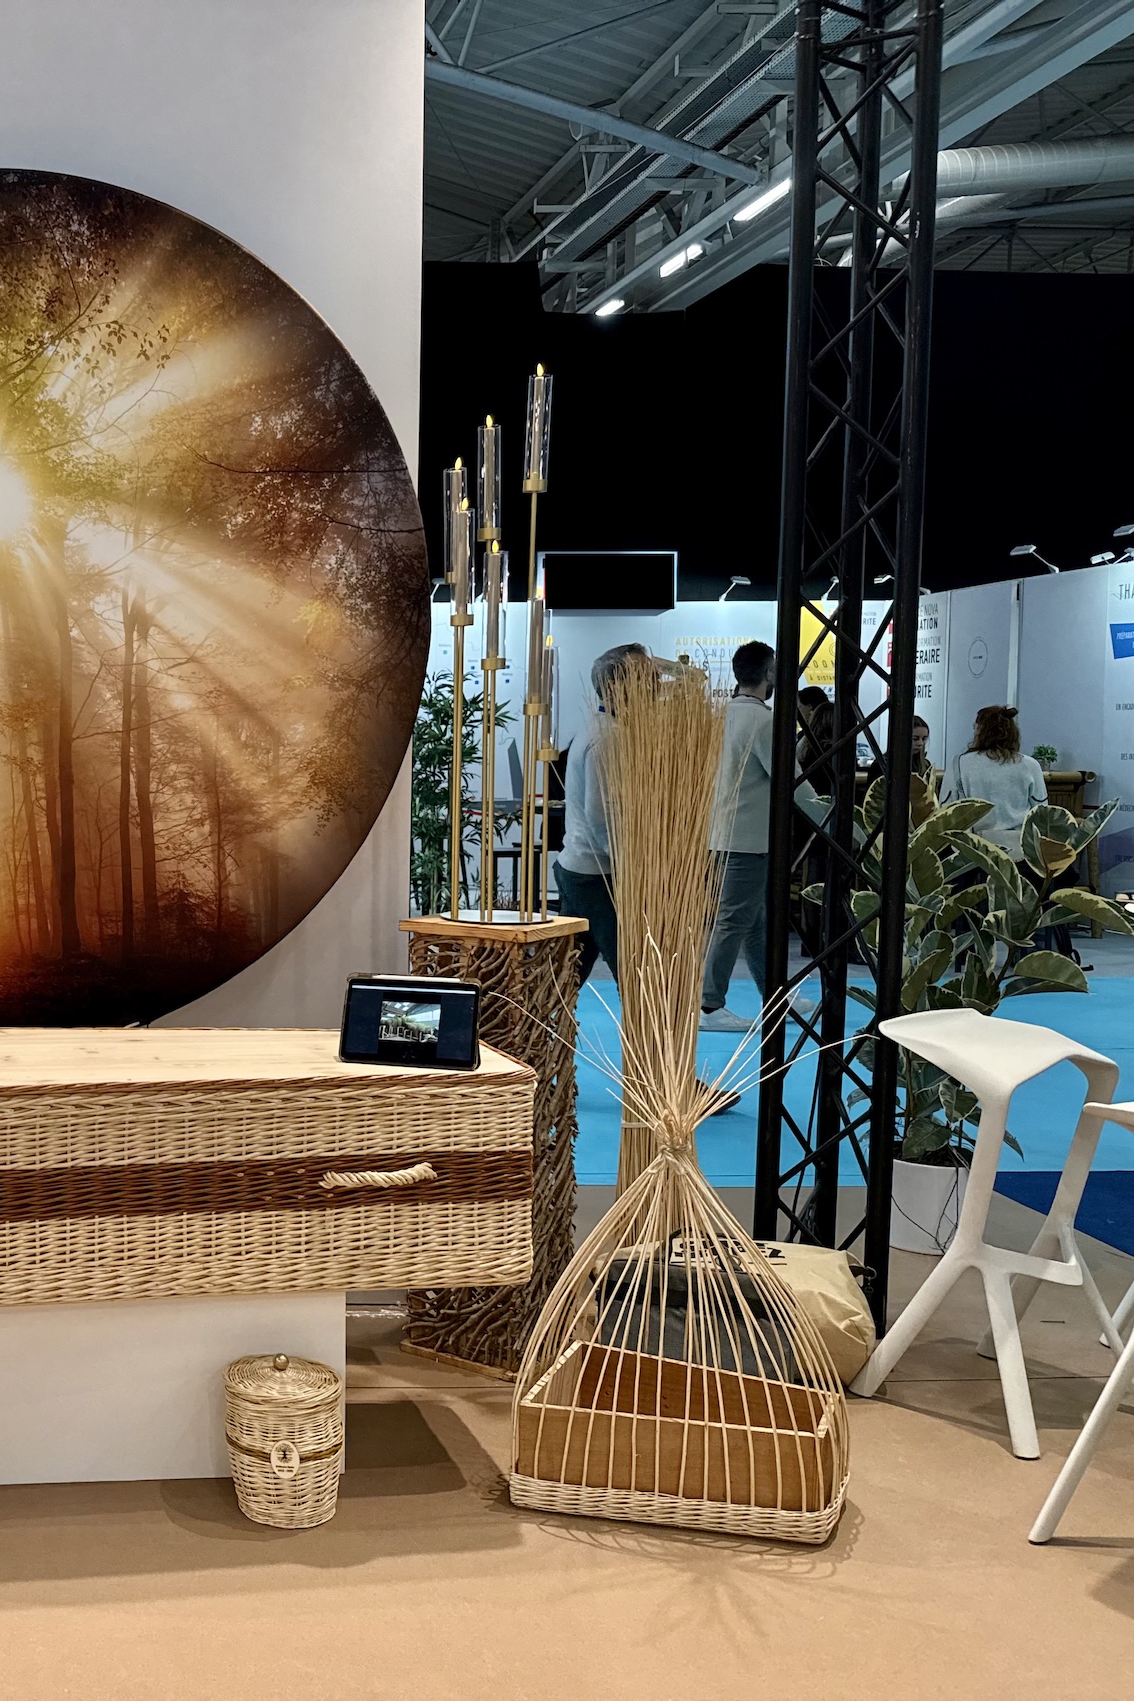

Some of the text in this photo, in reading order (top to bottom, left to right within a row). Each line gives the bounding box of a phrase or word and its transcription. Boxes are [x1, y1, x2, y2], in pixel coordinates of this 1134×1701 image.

[863, 618, 877, 626] RITE
[918, 617, 938, 631] ATION
[695, 649, 733, 658] CONDU
[915, 648, 940, 665] ERAIRE
